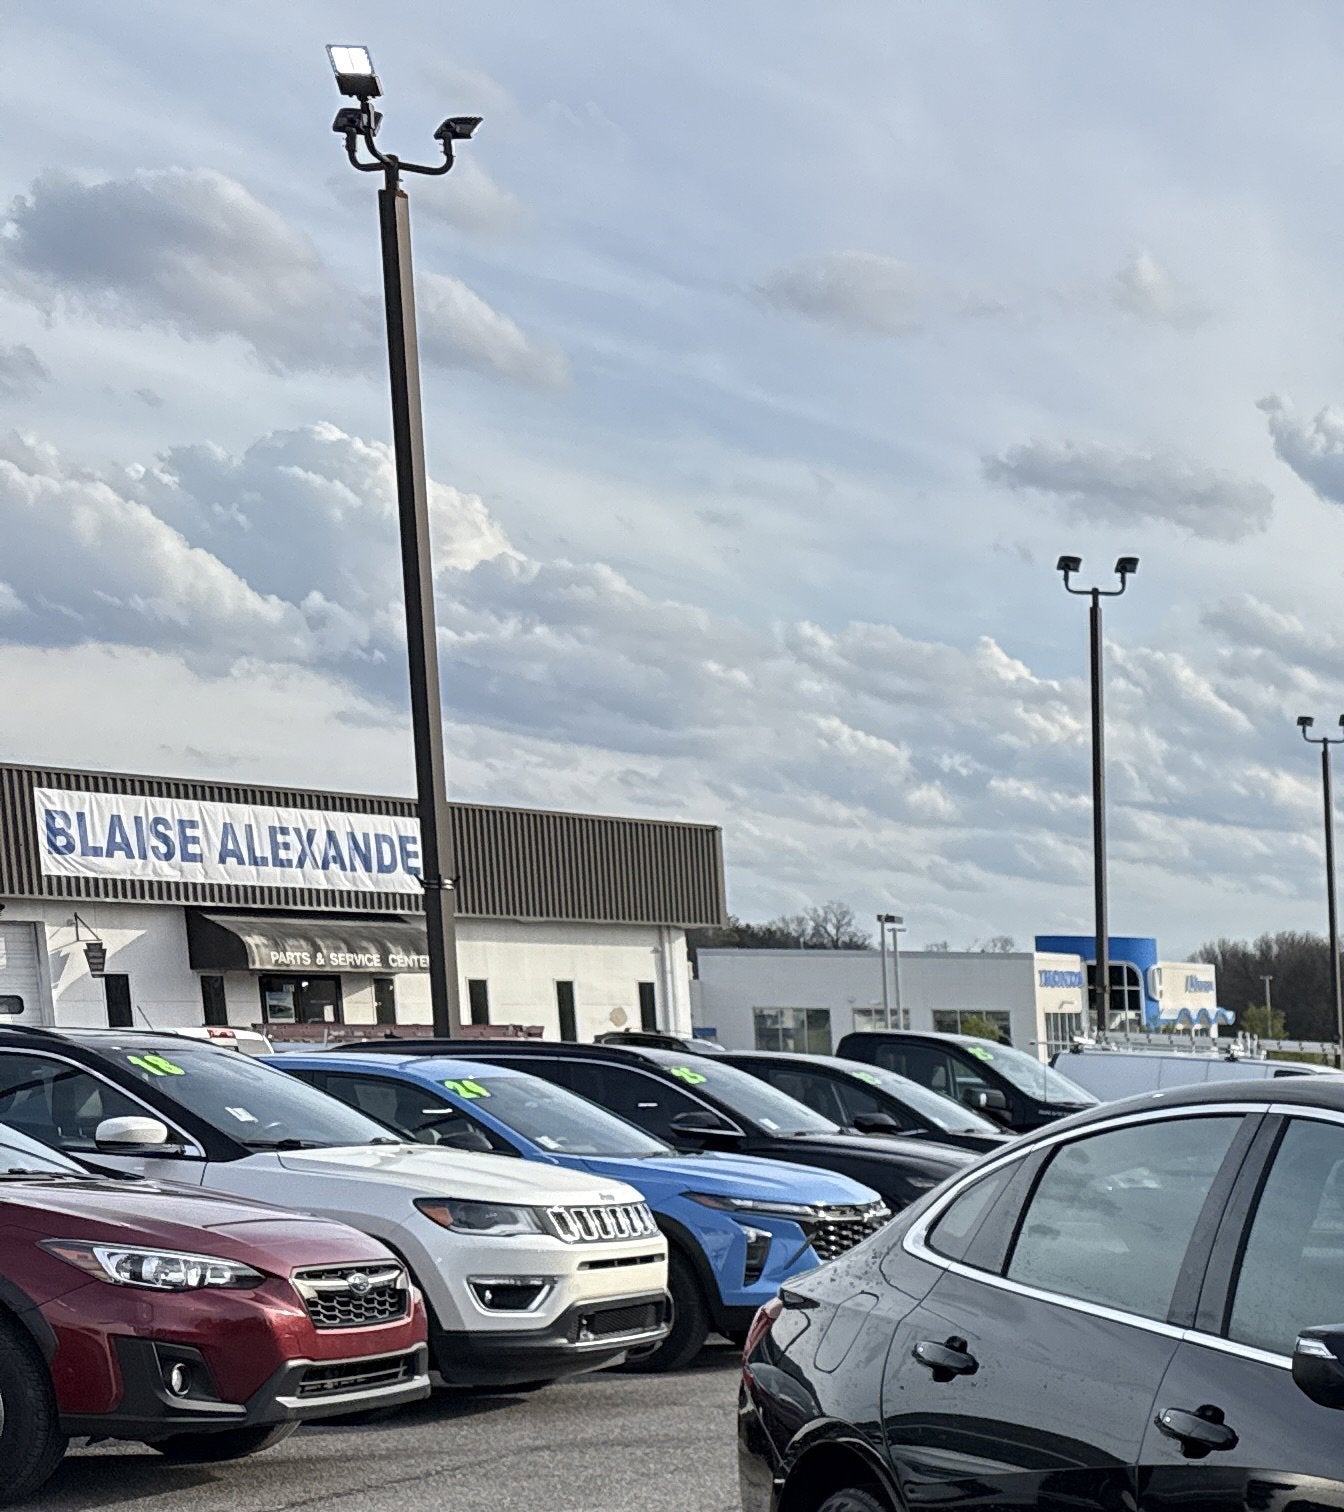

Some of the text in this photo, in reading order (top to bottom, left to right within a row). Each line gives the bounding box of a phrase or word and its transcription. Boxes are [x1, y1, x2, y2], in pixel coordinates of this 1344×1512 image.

[44, 808, 422, 876] BLAISE ALEXANDE
[270, 951, 312, 966] PARTS
[315, 952, 326, 966] &
[329, 952, 383, 967] SERVICE
